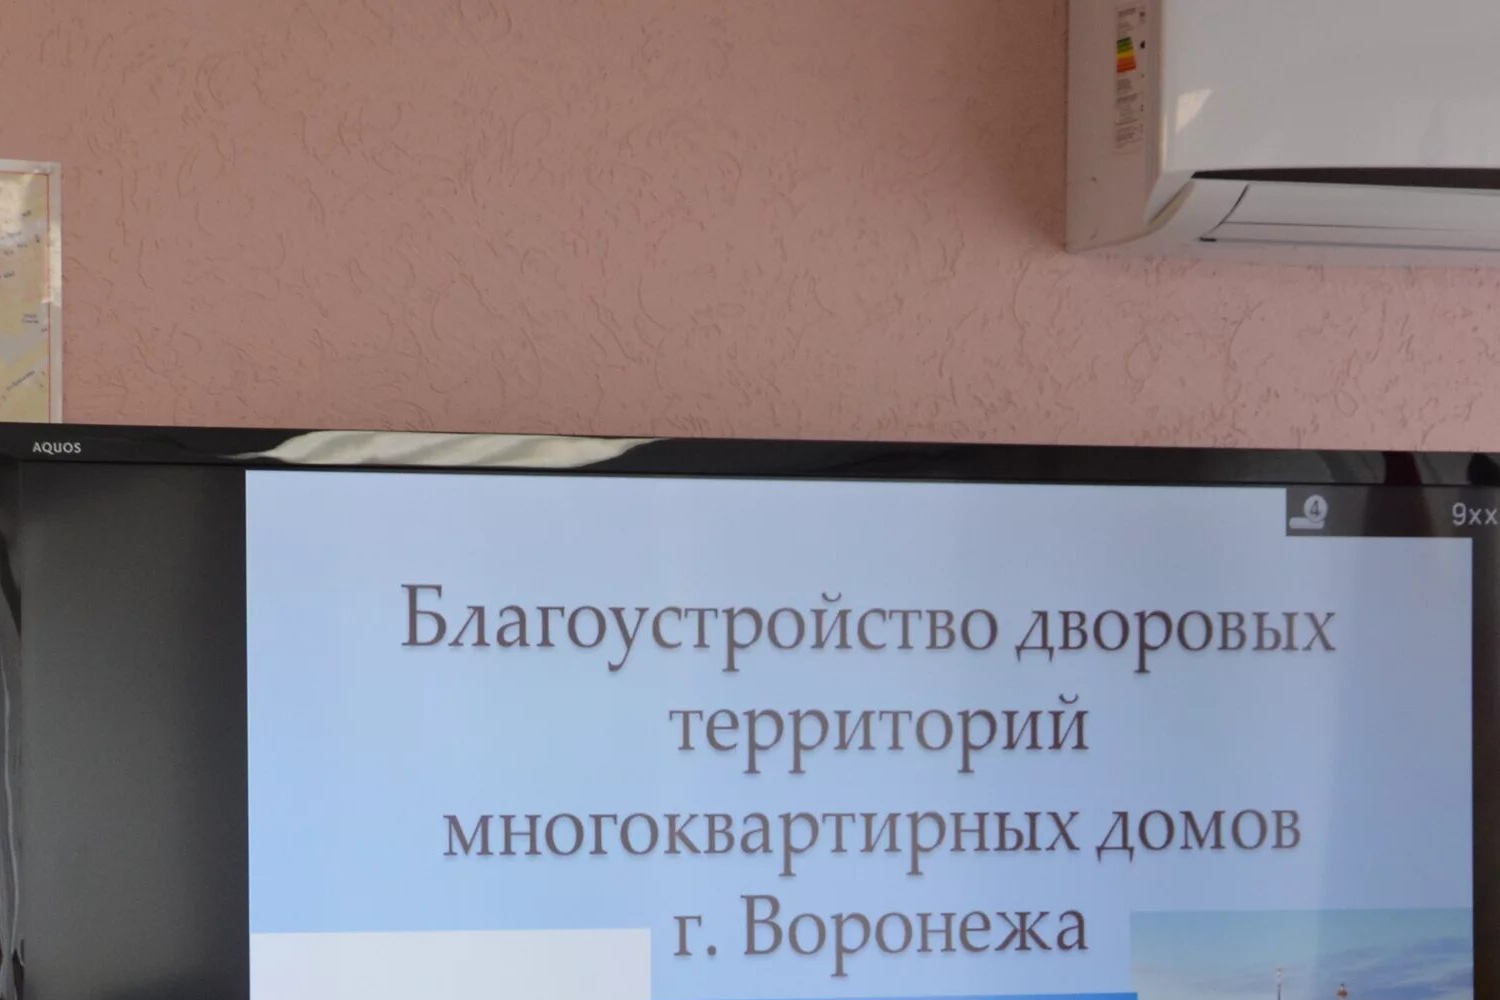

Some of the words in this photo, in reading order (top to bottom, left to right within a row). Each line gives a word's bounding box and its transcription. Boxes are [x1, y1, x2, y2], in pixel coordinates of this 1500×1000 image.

[32, 441, 82, 455] AQUOS
[400, 583, 998, 673] Благоустройство
[1015, 608, 1336, 674] дворовых
[668, 693, 1089, 774] территорий
[443, 808, 1080, 877] многоквартирных
[1096, 808, 1301, 862] домов
[673, 914, 717, 957] г.
[740, 894, 1089, 978] Воронежа
